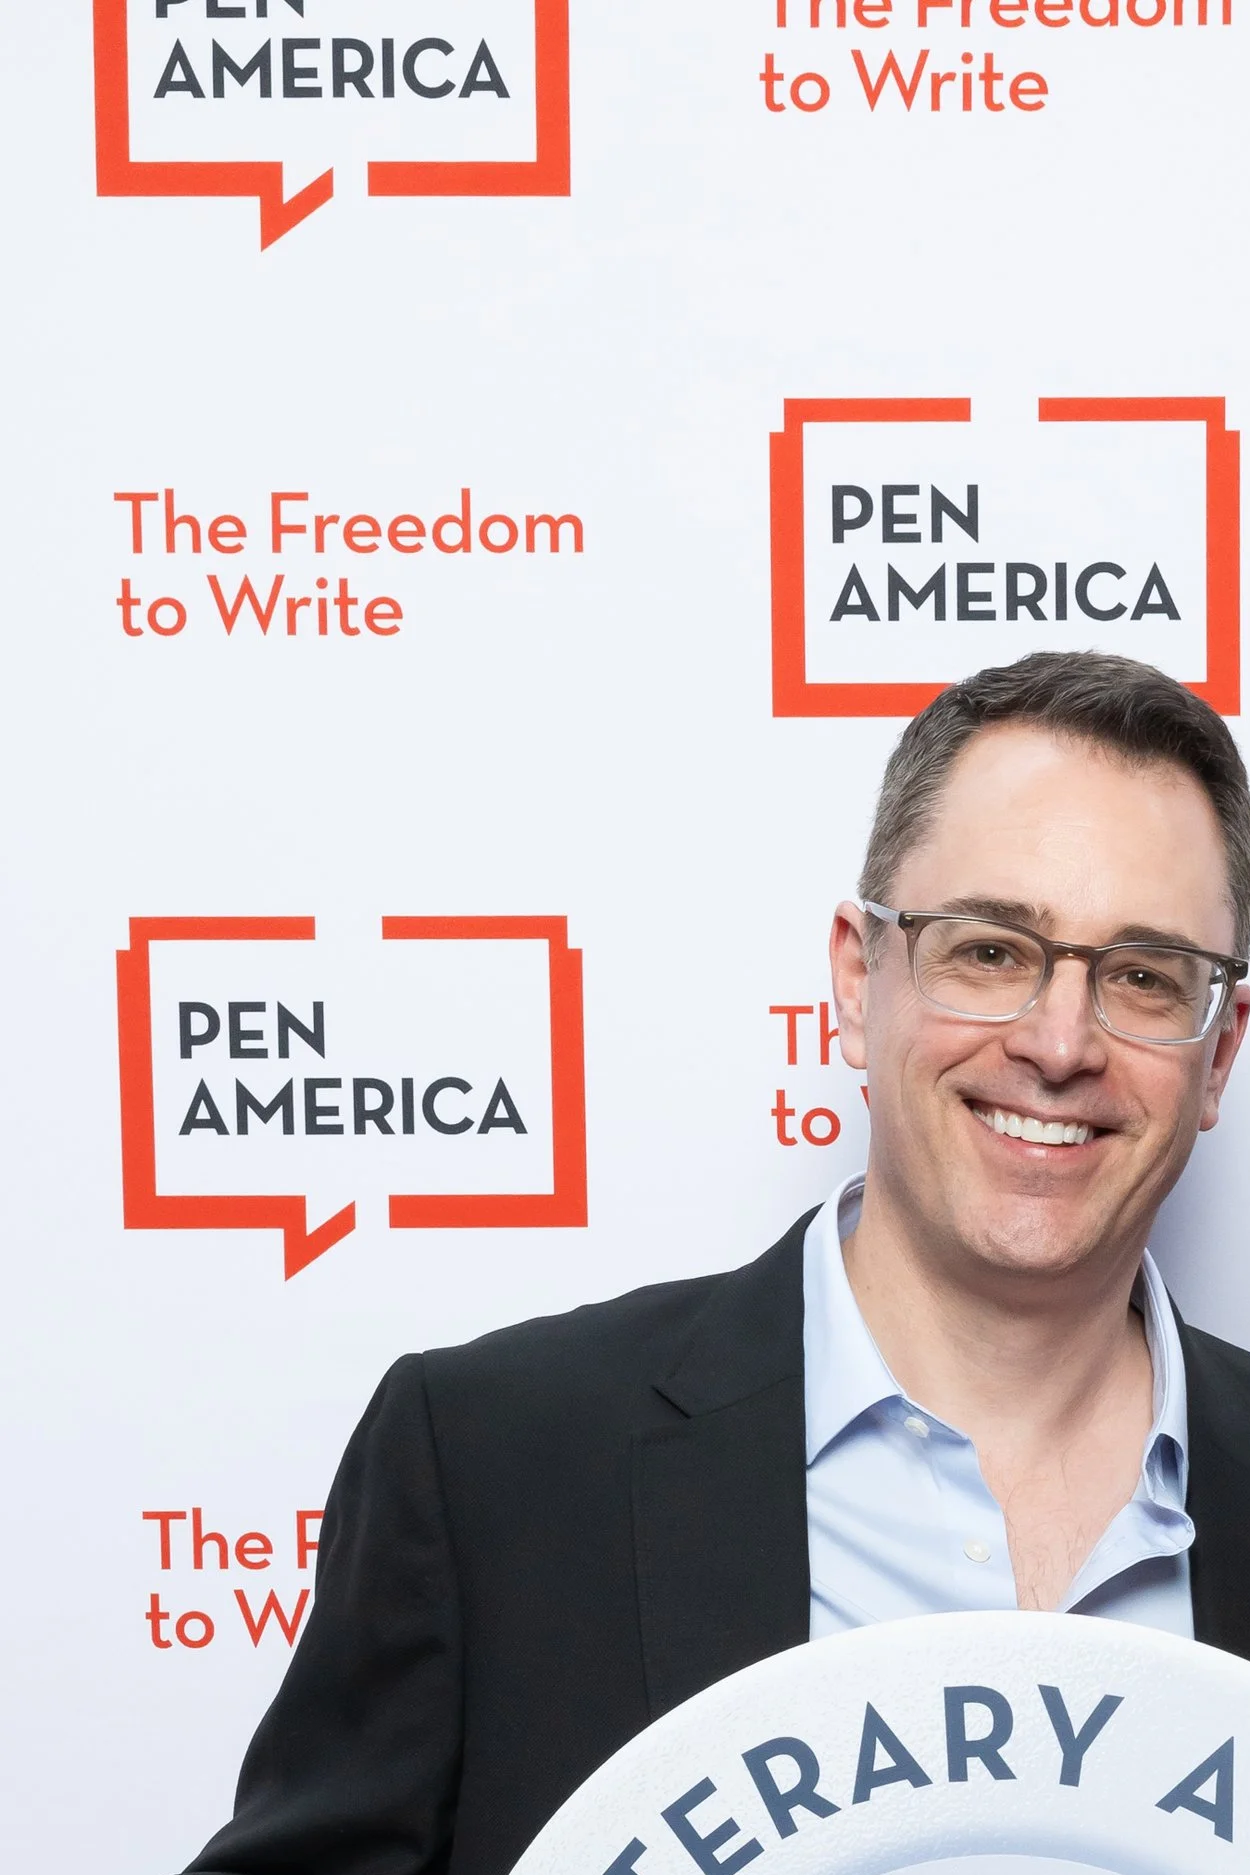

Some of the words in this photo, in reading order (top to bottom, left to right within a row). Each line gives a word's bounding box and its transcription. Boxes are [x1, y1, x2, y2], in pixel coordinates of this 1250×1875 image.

[154, 38, 510, 98] AMERICA
[759, 53, 830, 112] to
[852, 49, 1048, 112] Write
[114, 488, 247, 554] The
[272, 488, 583, 554] Freedom
[832, 485, 978, 543] PEN
[117, 579, 186, 636] to
[208, 574, 403, 636] Write
[830, 562, 1181, 621] AMERICA
[179, 1002, 325, 1058] PEN
[770, 1002, 840, 1065] Th
[179, 1077, 527, 1135] AMERICA
[771, 1090, 840, 1146] to
[142, 1508, 272, 1570] The
[145, 1594, 214, 1649] to
